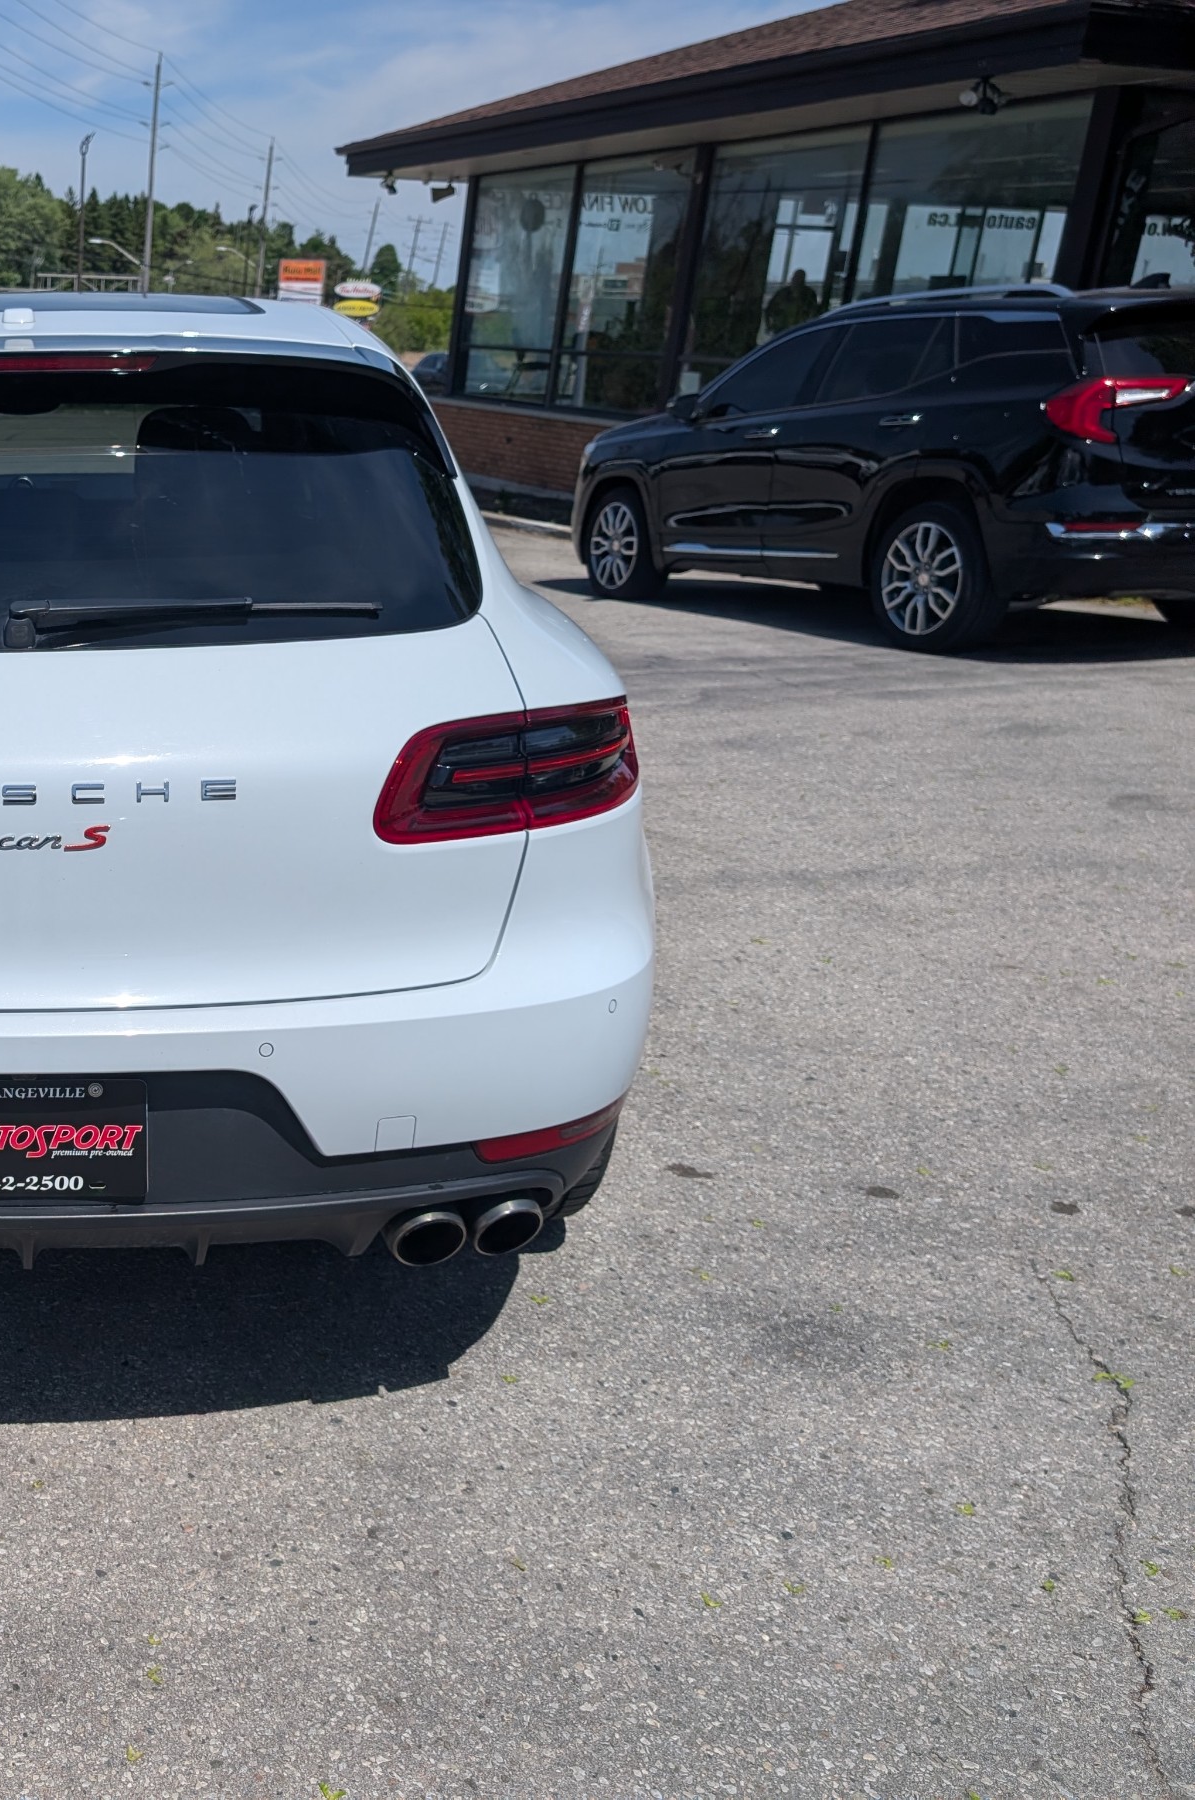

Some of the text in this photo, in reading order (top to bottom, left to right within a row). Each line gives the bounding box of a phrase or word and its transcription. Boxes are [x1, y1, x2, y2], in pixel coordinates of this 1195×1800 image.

[64, 824, 111, 852] S
[51, 1148, 134, 1159] premium pre-owned
